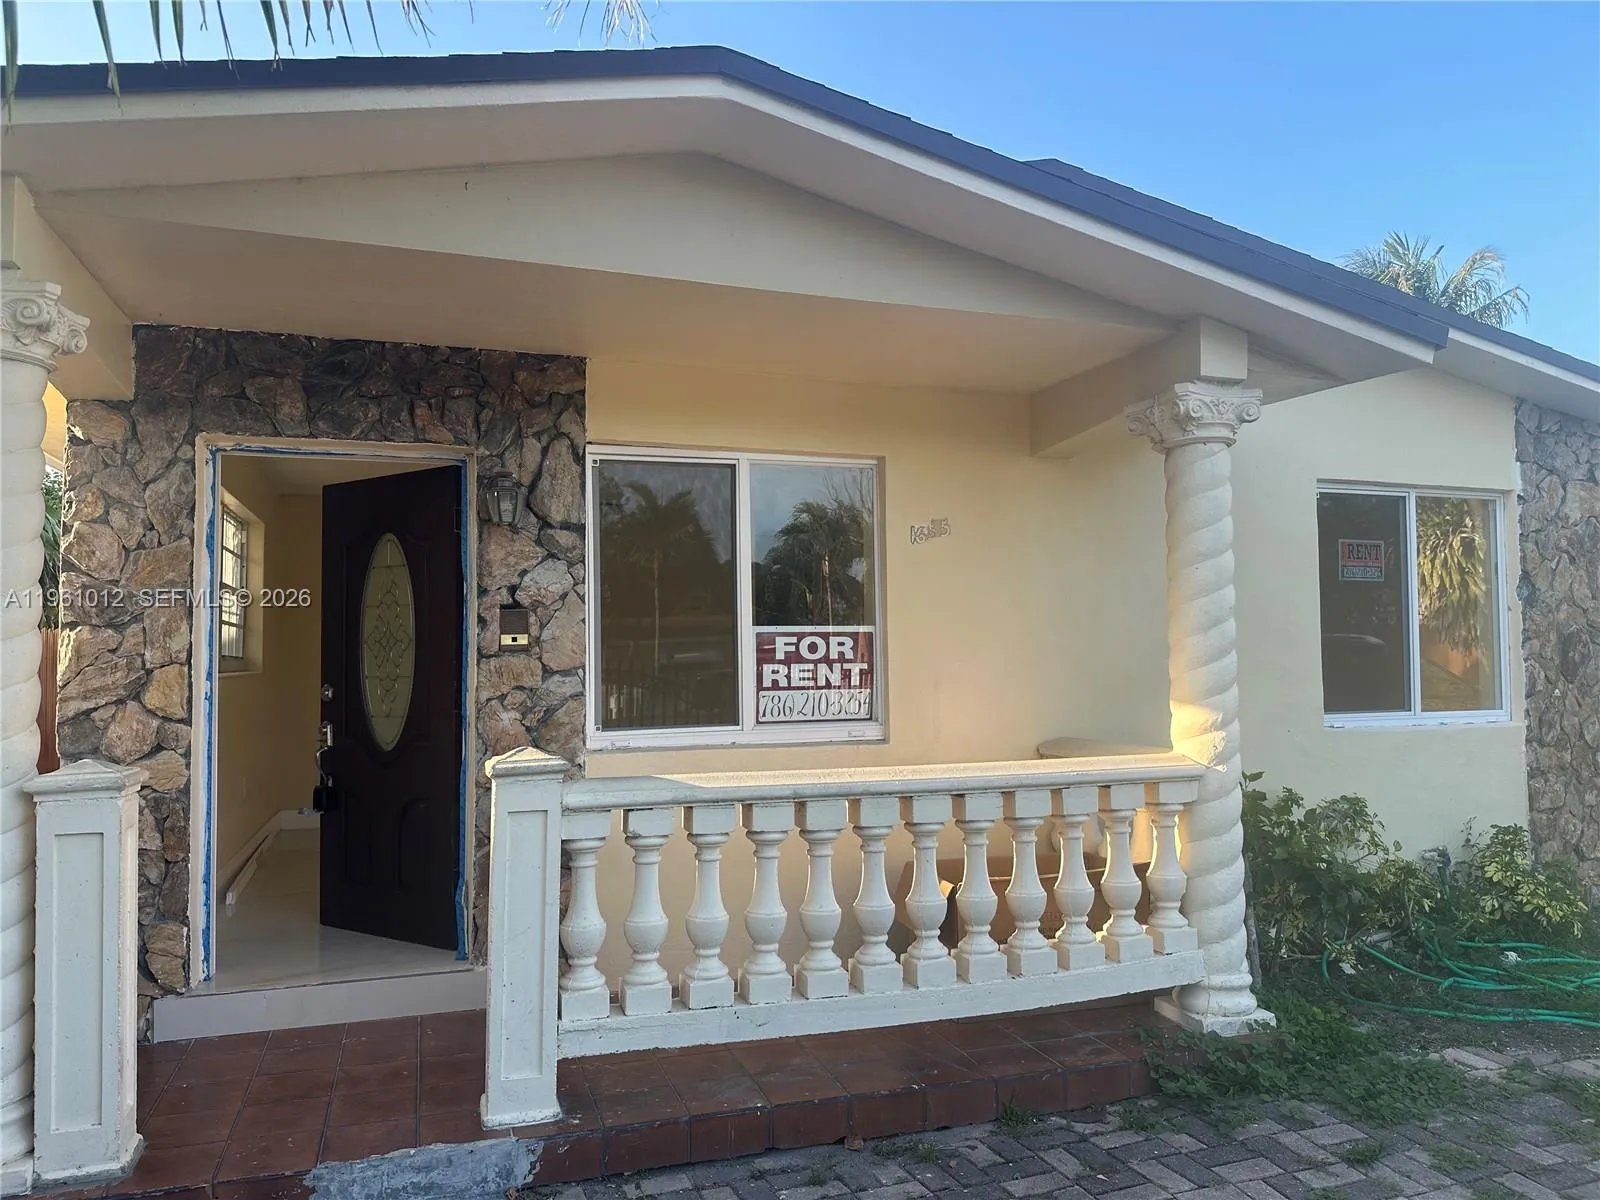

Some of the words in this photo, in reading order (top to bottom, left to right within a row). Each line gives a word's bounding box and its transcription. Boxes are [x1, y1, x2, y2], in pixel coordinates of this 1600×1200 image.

[1346, 543, 1382, 561] RENT
[775, 635, 855, 660] FOR
[762, 662, 868, 688] RENT
